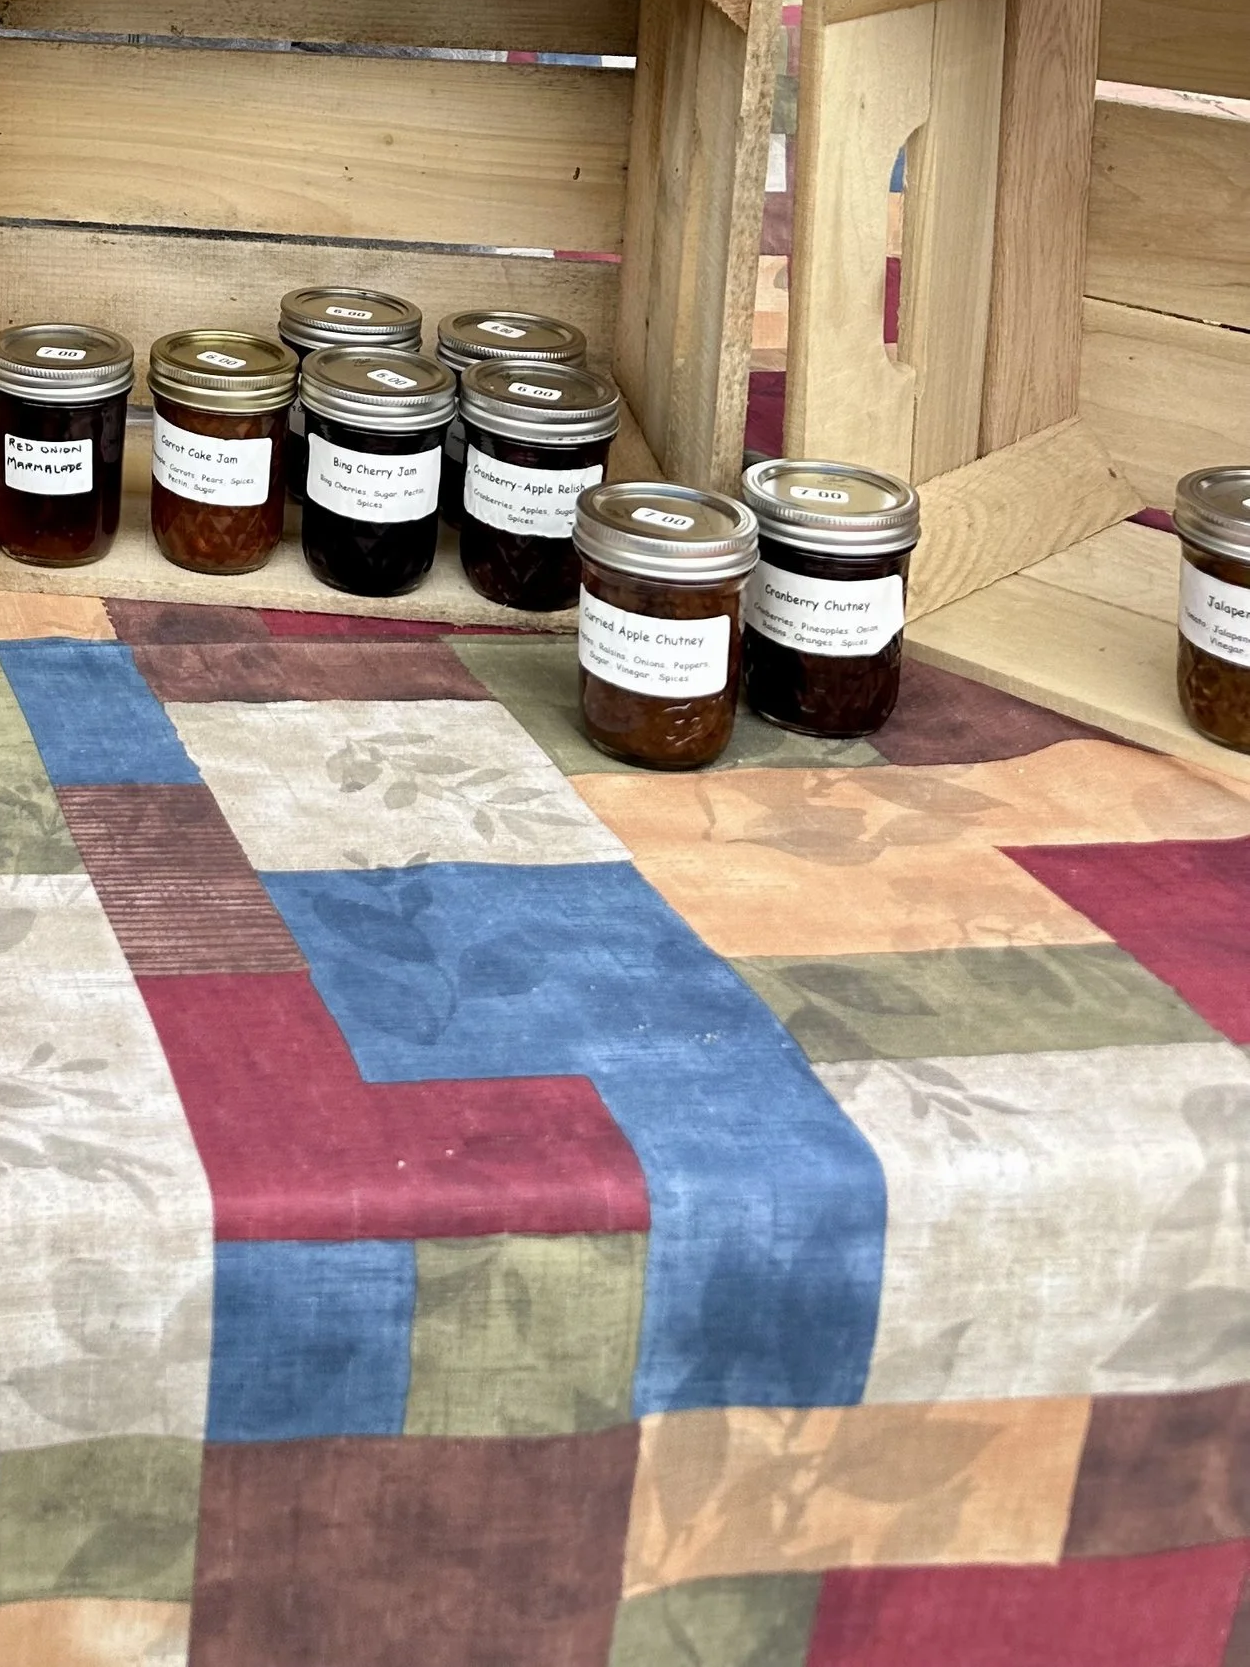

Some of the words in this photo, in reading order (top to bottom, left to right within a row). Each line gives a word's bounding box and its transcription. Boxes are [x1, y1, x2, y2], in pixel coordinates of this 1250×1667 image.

[8, 437, 34, 452] RED
[161, 435, 186, 455] Carrot
[188, 448, 212, 462] Cake
[216, 453, 238, 465] Jam
[7, 456, 83, 475] MARMALADE
[333, 456, 353, 474] Bing
[357, 464, 393, 479] Cherry
[397, 466, 417, 477] Jam
[473, 464, 553, 496] Cranberry-Apple
[558, 483, 586, 494] Relish
[765, 583, 819, 612] Cranberry
[824, 600, 871, 613] Chutney
[584, 607, 614, 632] Curried
[619, 625, 650, 643] Apple
[655, 634, 704, 647] Chutney
